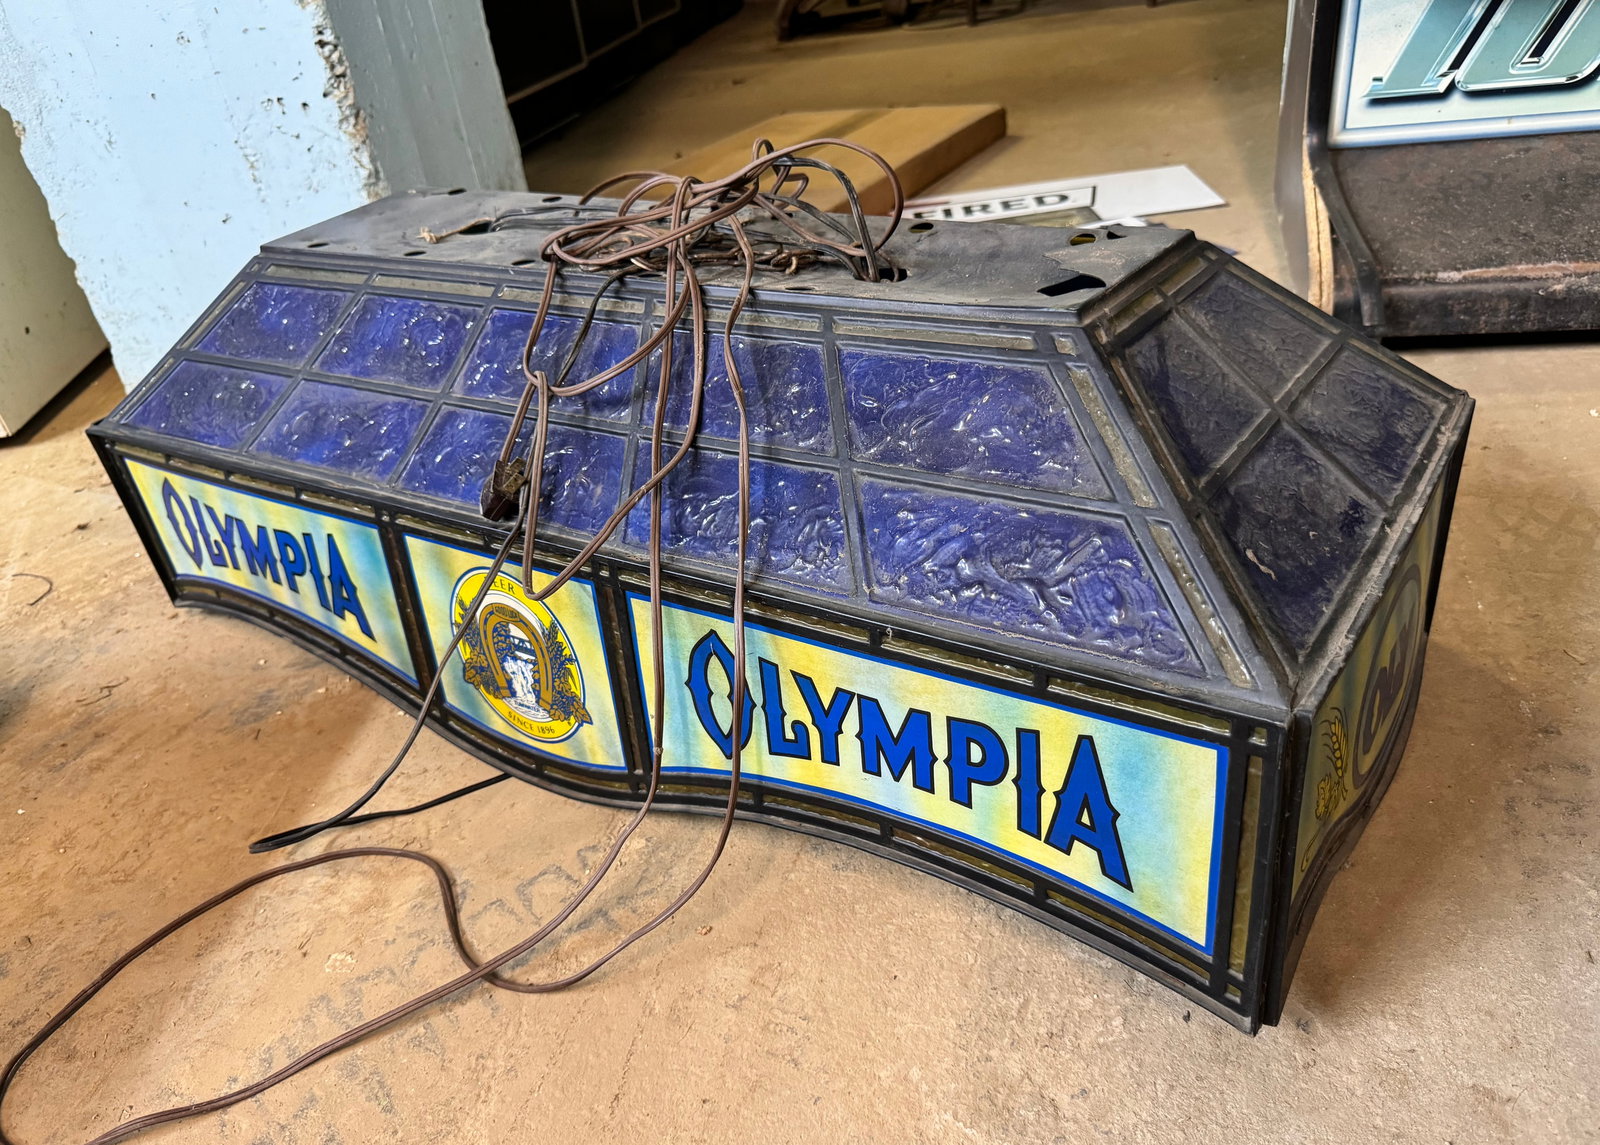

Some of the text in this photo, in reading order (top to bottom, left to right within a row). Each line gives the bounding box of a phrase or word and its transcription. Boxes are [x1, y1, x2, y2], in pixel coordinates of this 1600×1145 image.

[162, 477, 377, 643] OLYMPIA
[507, 711, 556, 734] SINCE 1896
[685, 628, 1134, 893] OLYMPIA
